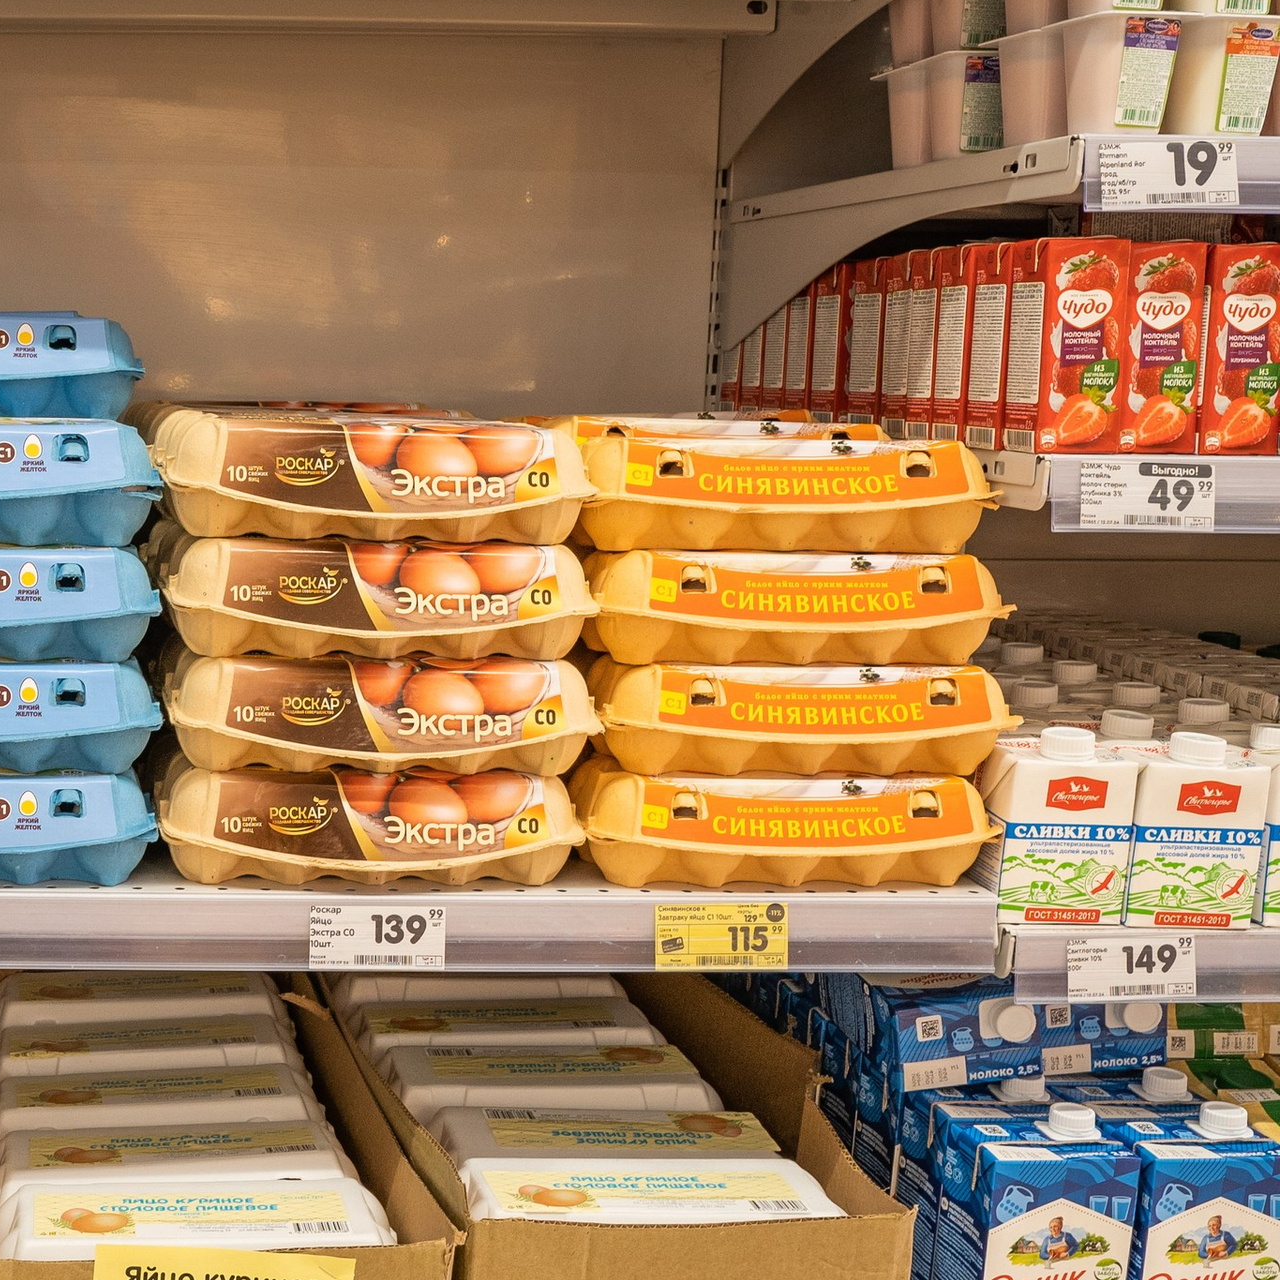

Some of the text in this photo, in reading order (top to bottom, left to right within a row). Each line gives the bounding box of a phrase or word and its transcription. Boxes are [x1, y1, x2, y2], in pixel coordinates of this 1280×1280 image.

[1219, 142, 1232, 152] 99
[1166, 141, 1218, 186] 19
[1063, 330, 1101, 338] МОЛОЧНЫЙ
[276, 456, 334, 471] РОСКАР
[723, 464, 752, 472] белое
[754, 465, 780, 473] яйцо
[791, 465, 823, 473] ярким
[1152, 465, 1199, 477] Выгодно!
[226, 465, 247, 483] 10
[390, 469, 506, 503] Экстра
[698, 473, 899, 496] СИНЯВИНСКОЕ
[1198, 481, 1212, 491] 99
[1148, 478, 1195, 512] 49
[394, 587, 508, 621] Экстра
[730, 702, 924, 726] СИНЯВИНСКОЕ
[396, 708, 512, 742] Экстра
[220, 816, 242, 833] 10
[712, 815, 906, 839] СИНЯВИНСКОЕ
[1014, 825, 1130, 841] СЛИВКИ 10%
[384, 816, 495, 851] Экстра
[310, 906, 341, 915] Роскар
[429, 909, 443, 919] 99
[1029, 910, 1096, 920] ГОСТ 31451-2013
[310, 917, 332, 925] Яйцо
[371, 914, 427, 944] 139
[310, 929, 341, 937] Экстра
[727, 926, 769, 952] 115
[1179, 938, 1192, 947] 99
[1122, 944, 1177, 974] 149
